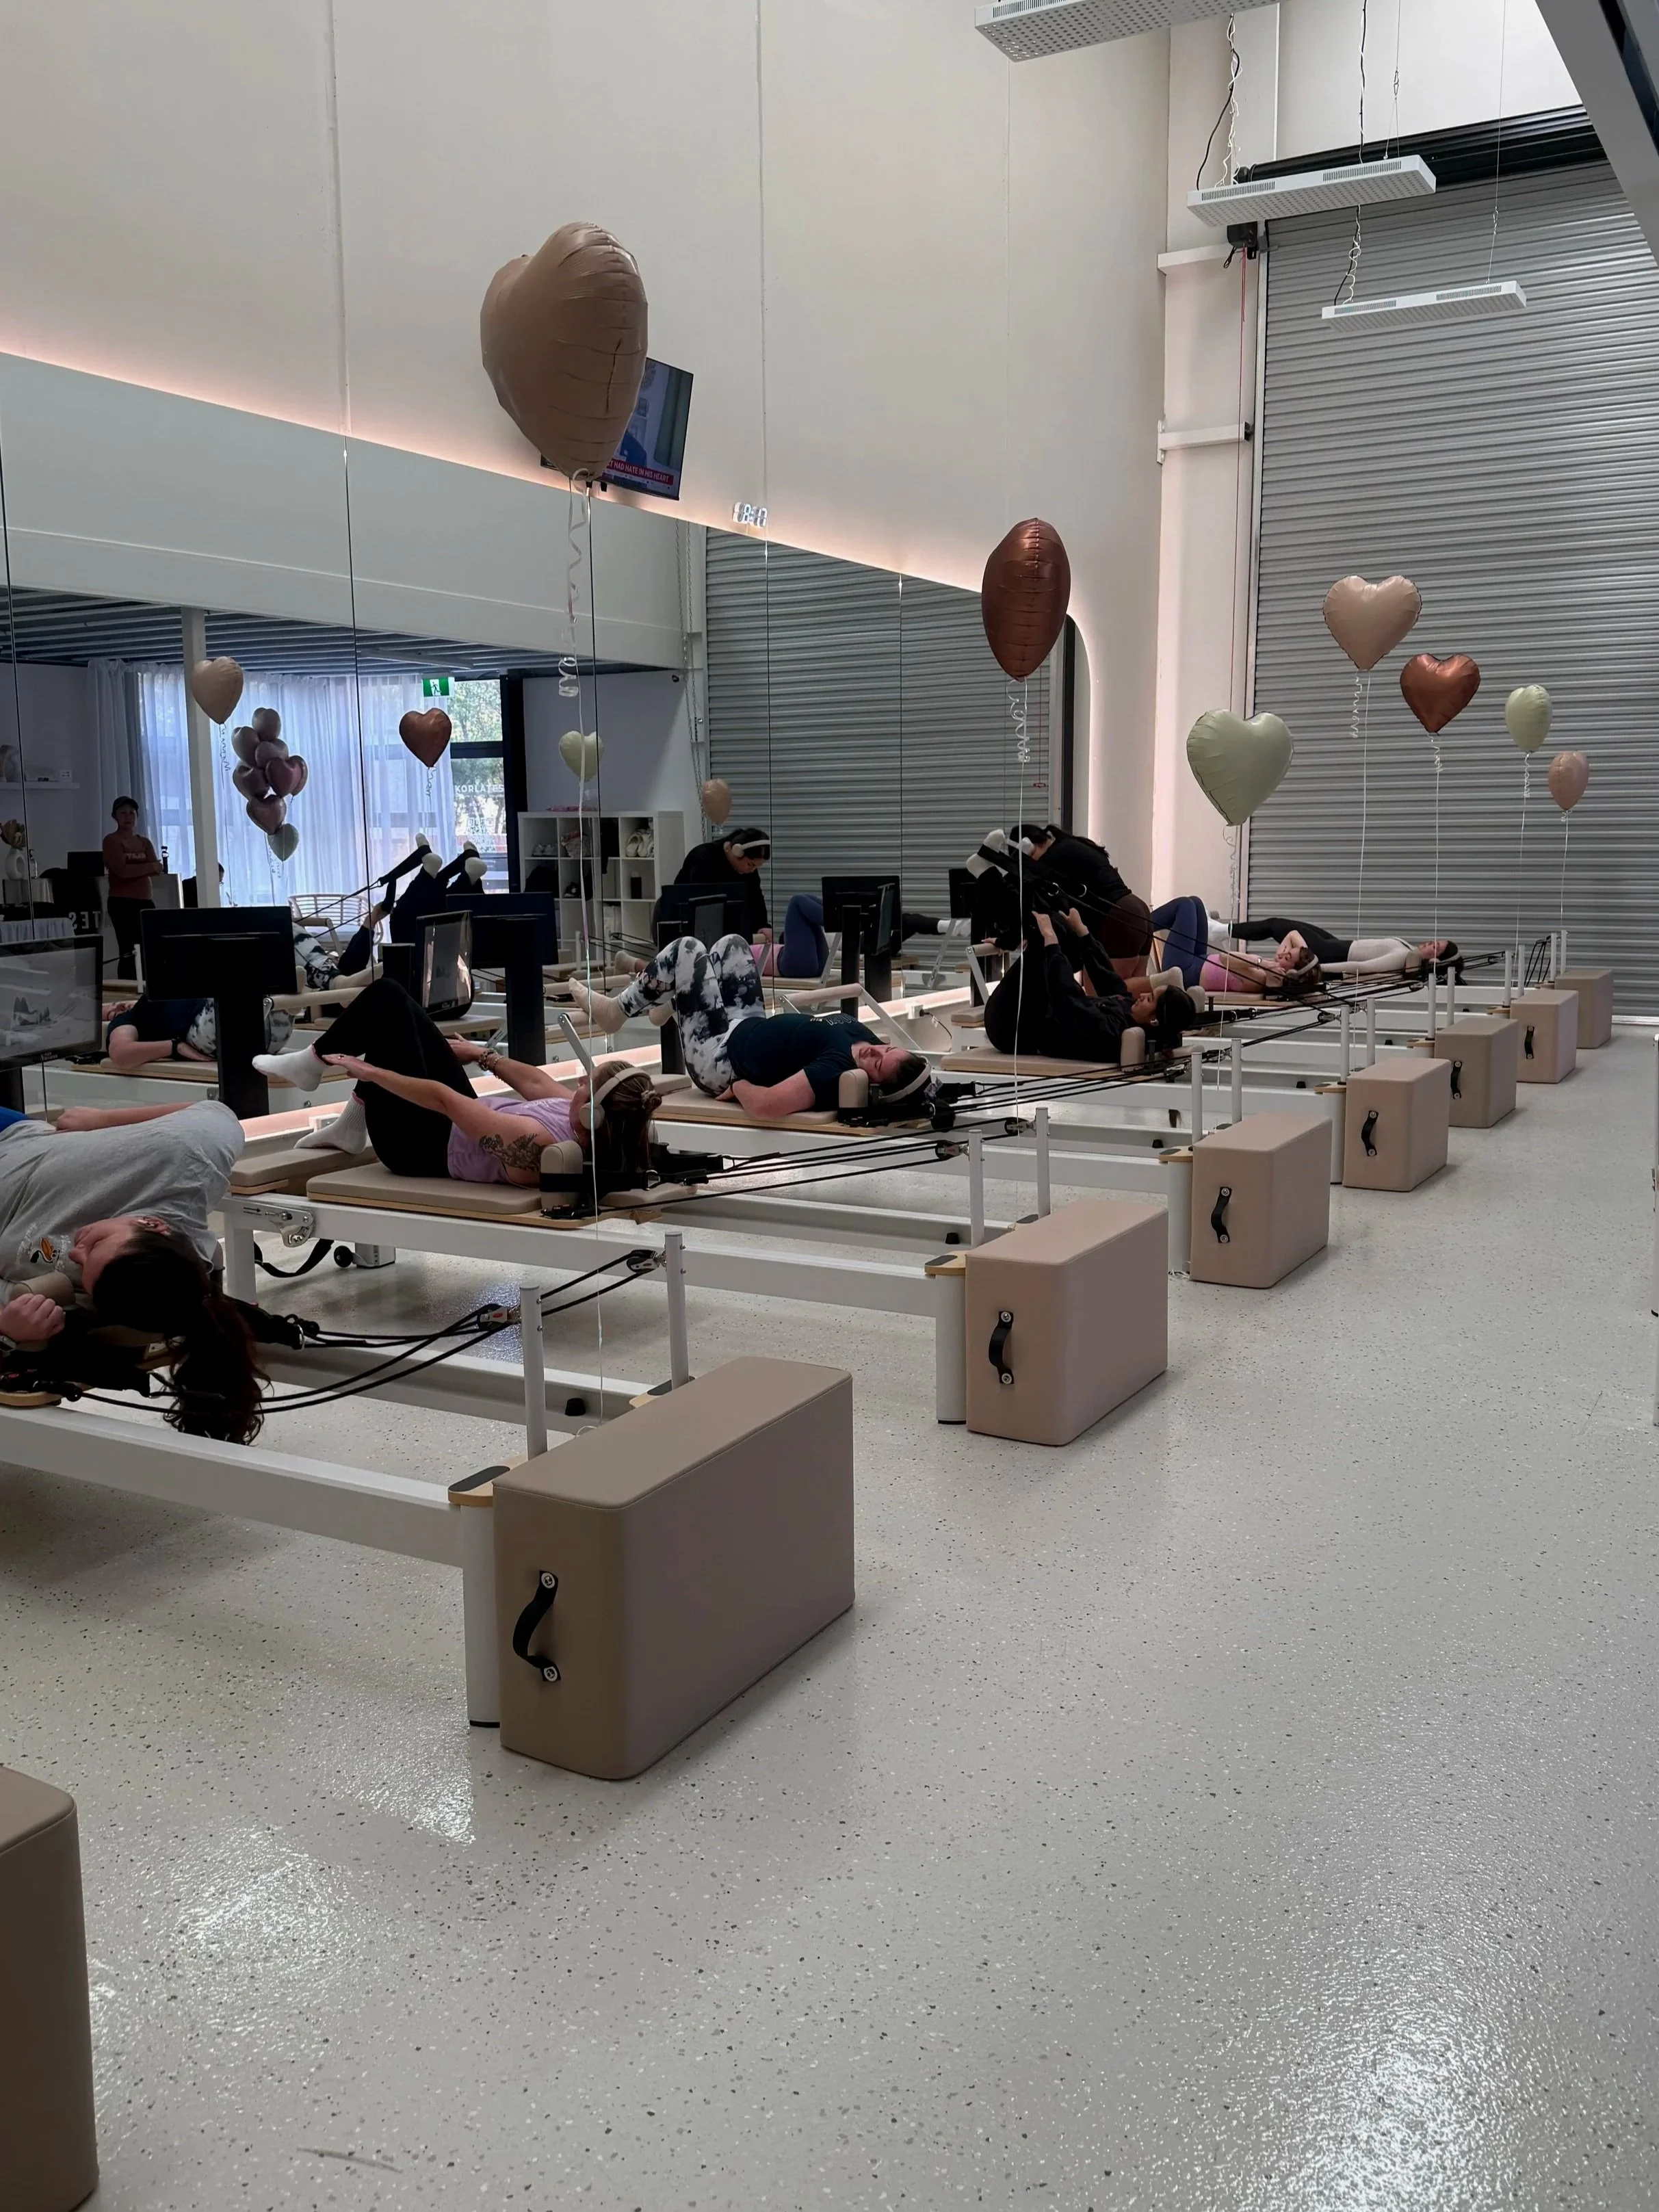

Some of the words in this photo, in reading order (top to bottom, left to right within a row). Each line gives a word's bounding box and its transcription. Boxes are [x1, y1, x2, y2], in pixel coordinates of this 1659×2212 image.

[614, 460, 625, 470] HAD
[625, 463, 638, 474] HATE
[639, 467, 644, 476] IN
[644, 469, 653, 478] HIS
[653, 471, 669, 482] HEART
